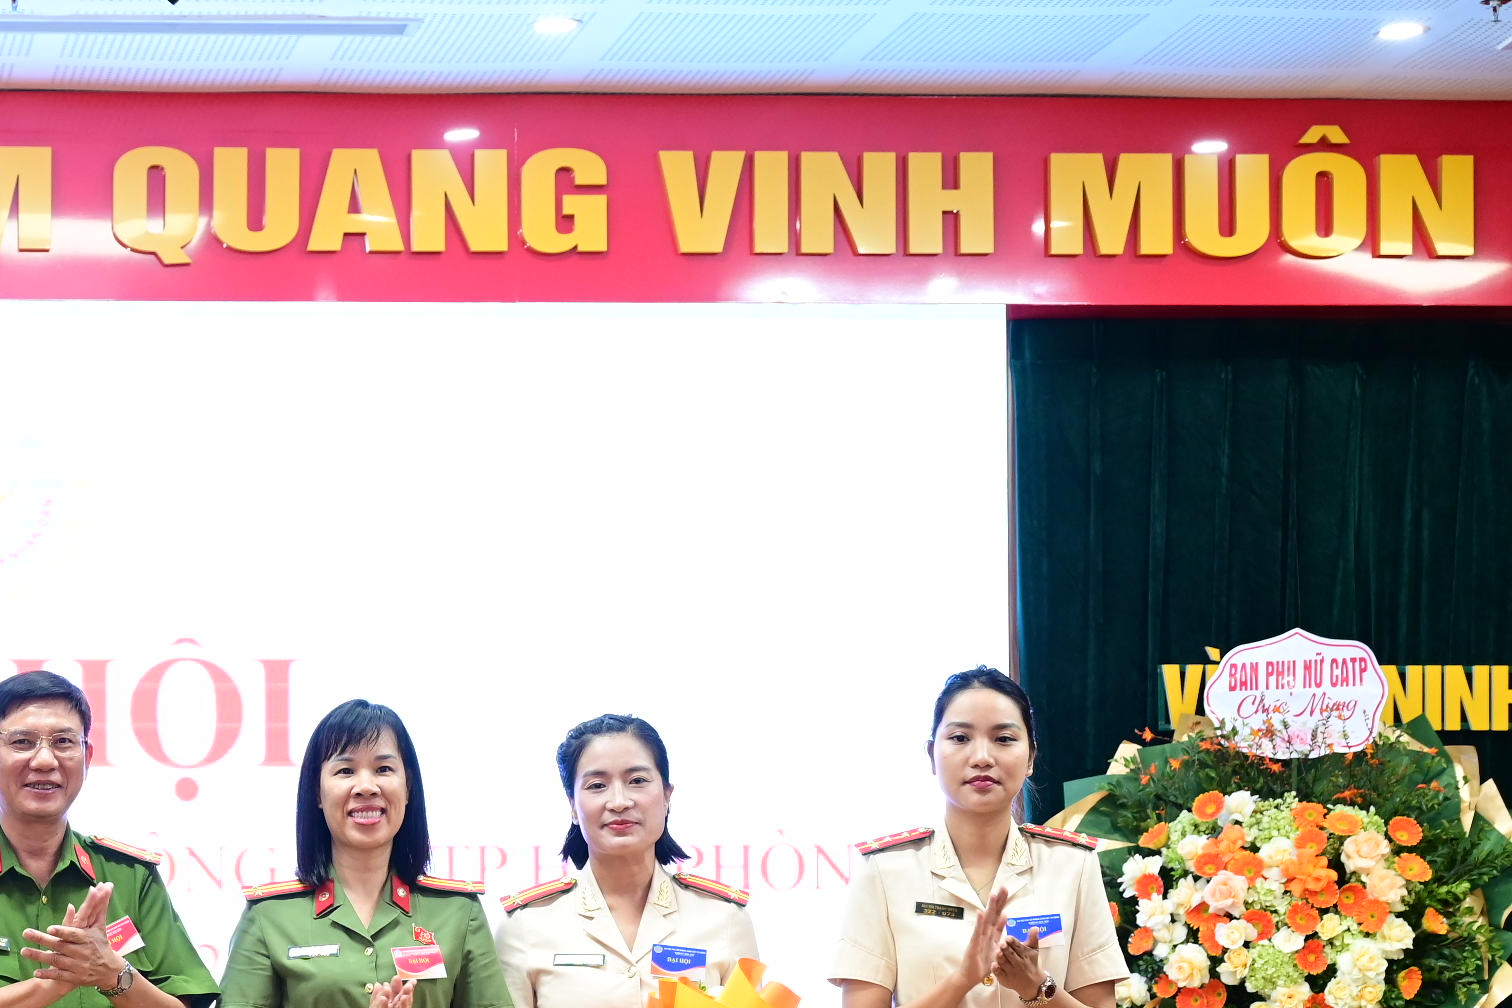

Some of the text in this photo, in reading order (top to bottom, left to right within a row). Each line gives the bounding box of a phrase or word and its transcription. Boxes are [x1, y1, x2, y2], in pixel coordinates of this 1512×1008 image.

[111, 144, 607, 267] QUANG
[658, 149, 995, 257] VINH
[1044, 124, 1476, 259] MUÔN
[1229, 652, 1368, 697] BAN PHỤ NỮ CATP
